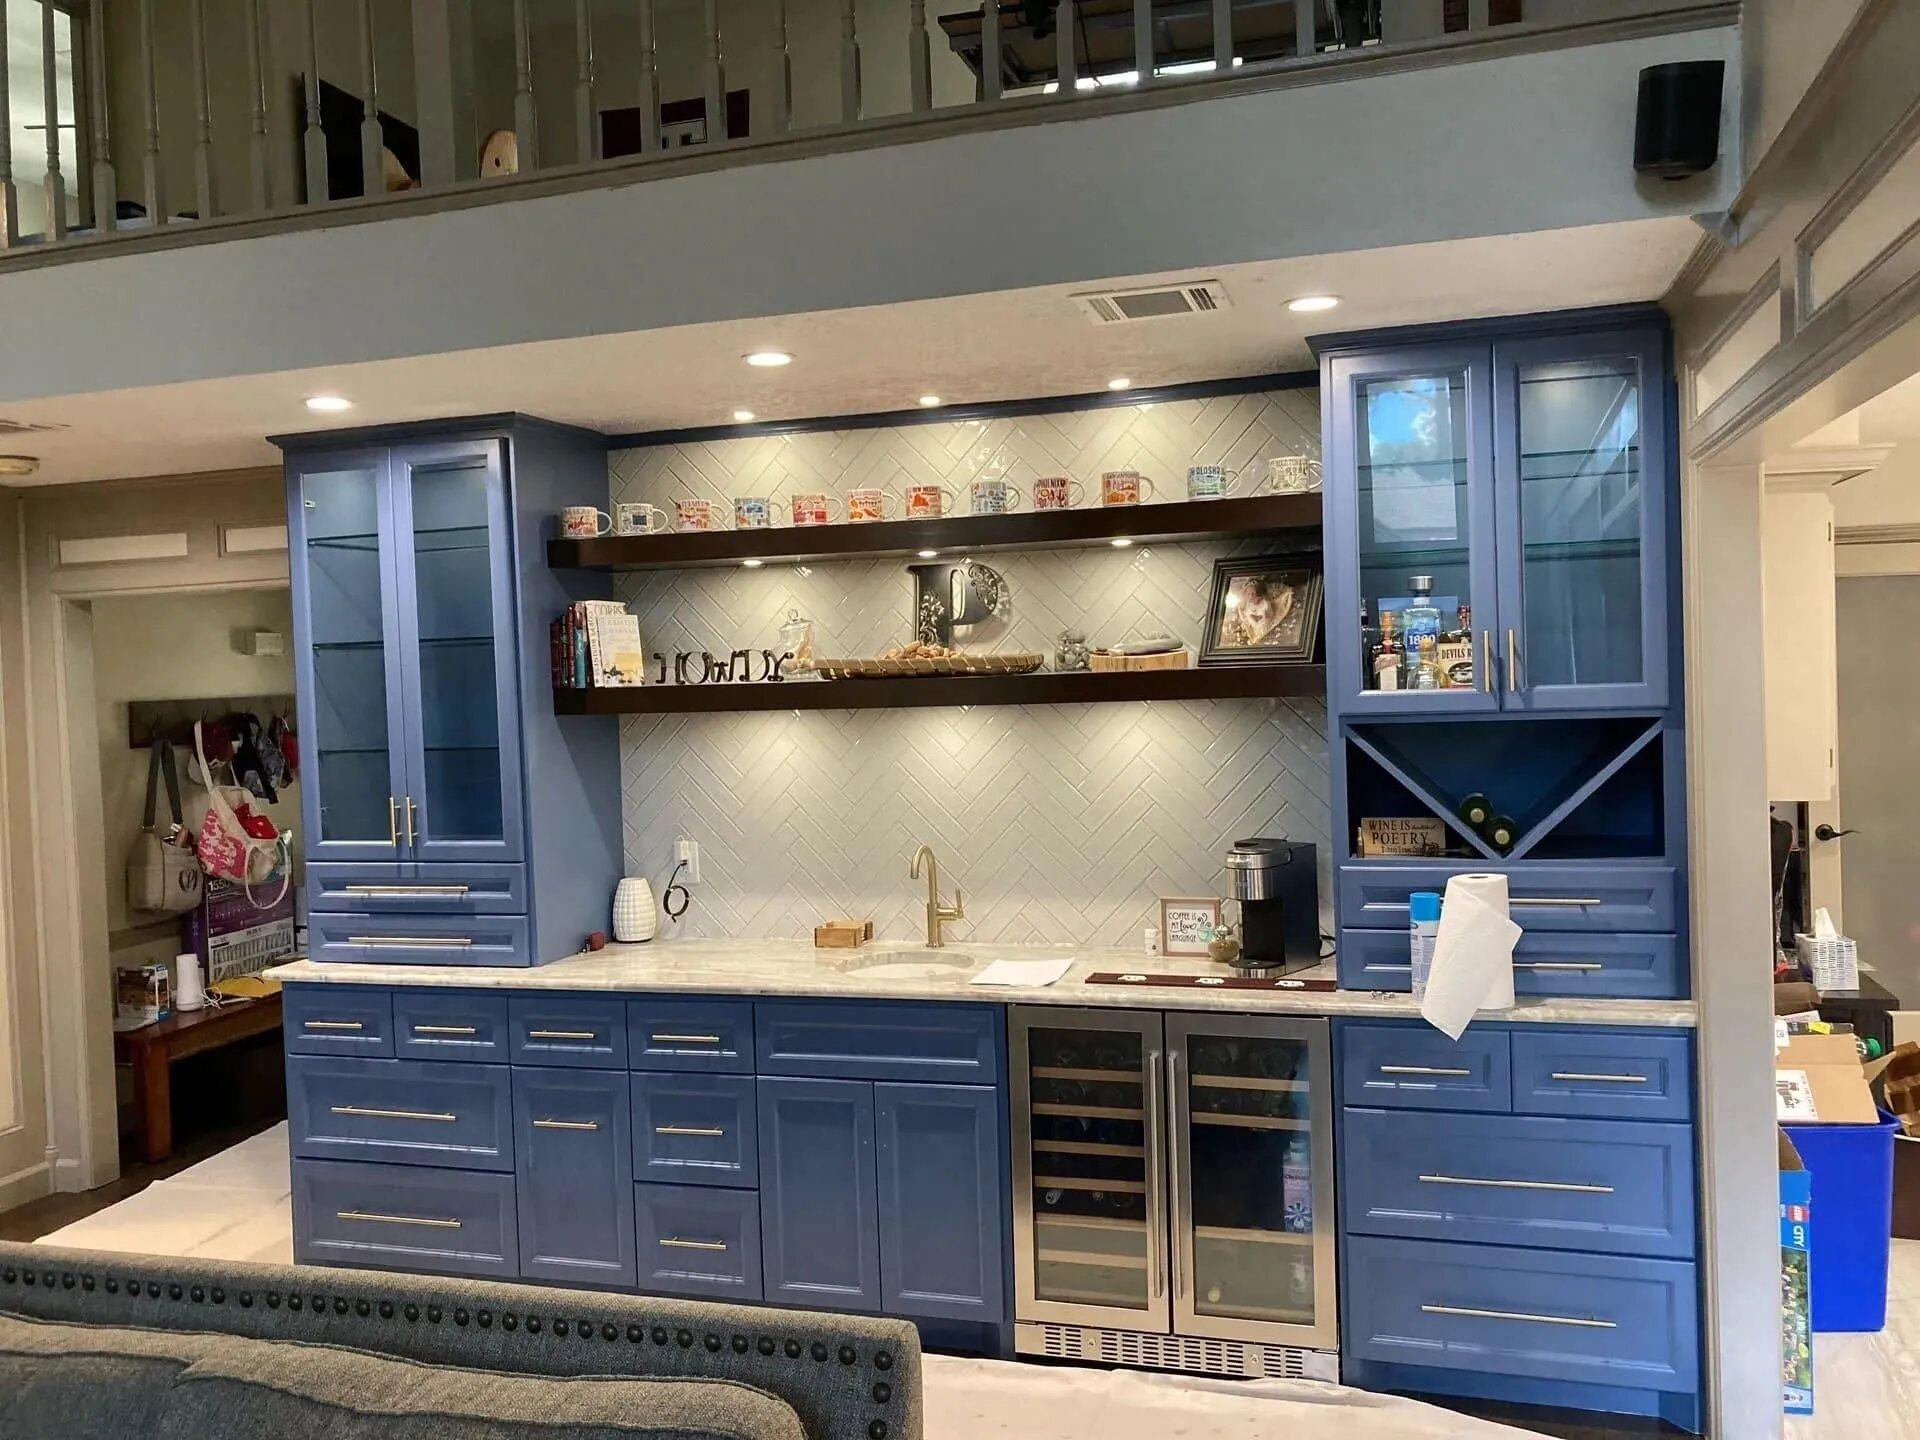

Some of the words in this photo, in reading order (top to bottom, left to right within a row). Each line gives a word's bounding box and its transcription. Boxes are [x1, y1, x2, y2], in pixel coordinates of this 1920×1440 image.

[1441, 648, 1465, 659] DEVILS
[653, 649, 794, 684] HOWDY
[1368, 820, 1397, 831] WINE
[1400, 820, 1411, 830] IS
[1372, 831, 1429, 845] POETRY
[1168, 912, 1190, 920] COFFEE
[1191, 912, 1197, 920] IS
[1793, 1225, 1804, 1247] CITY
